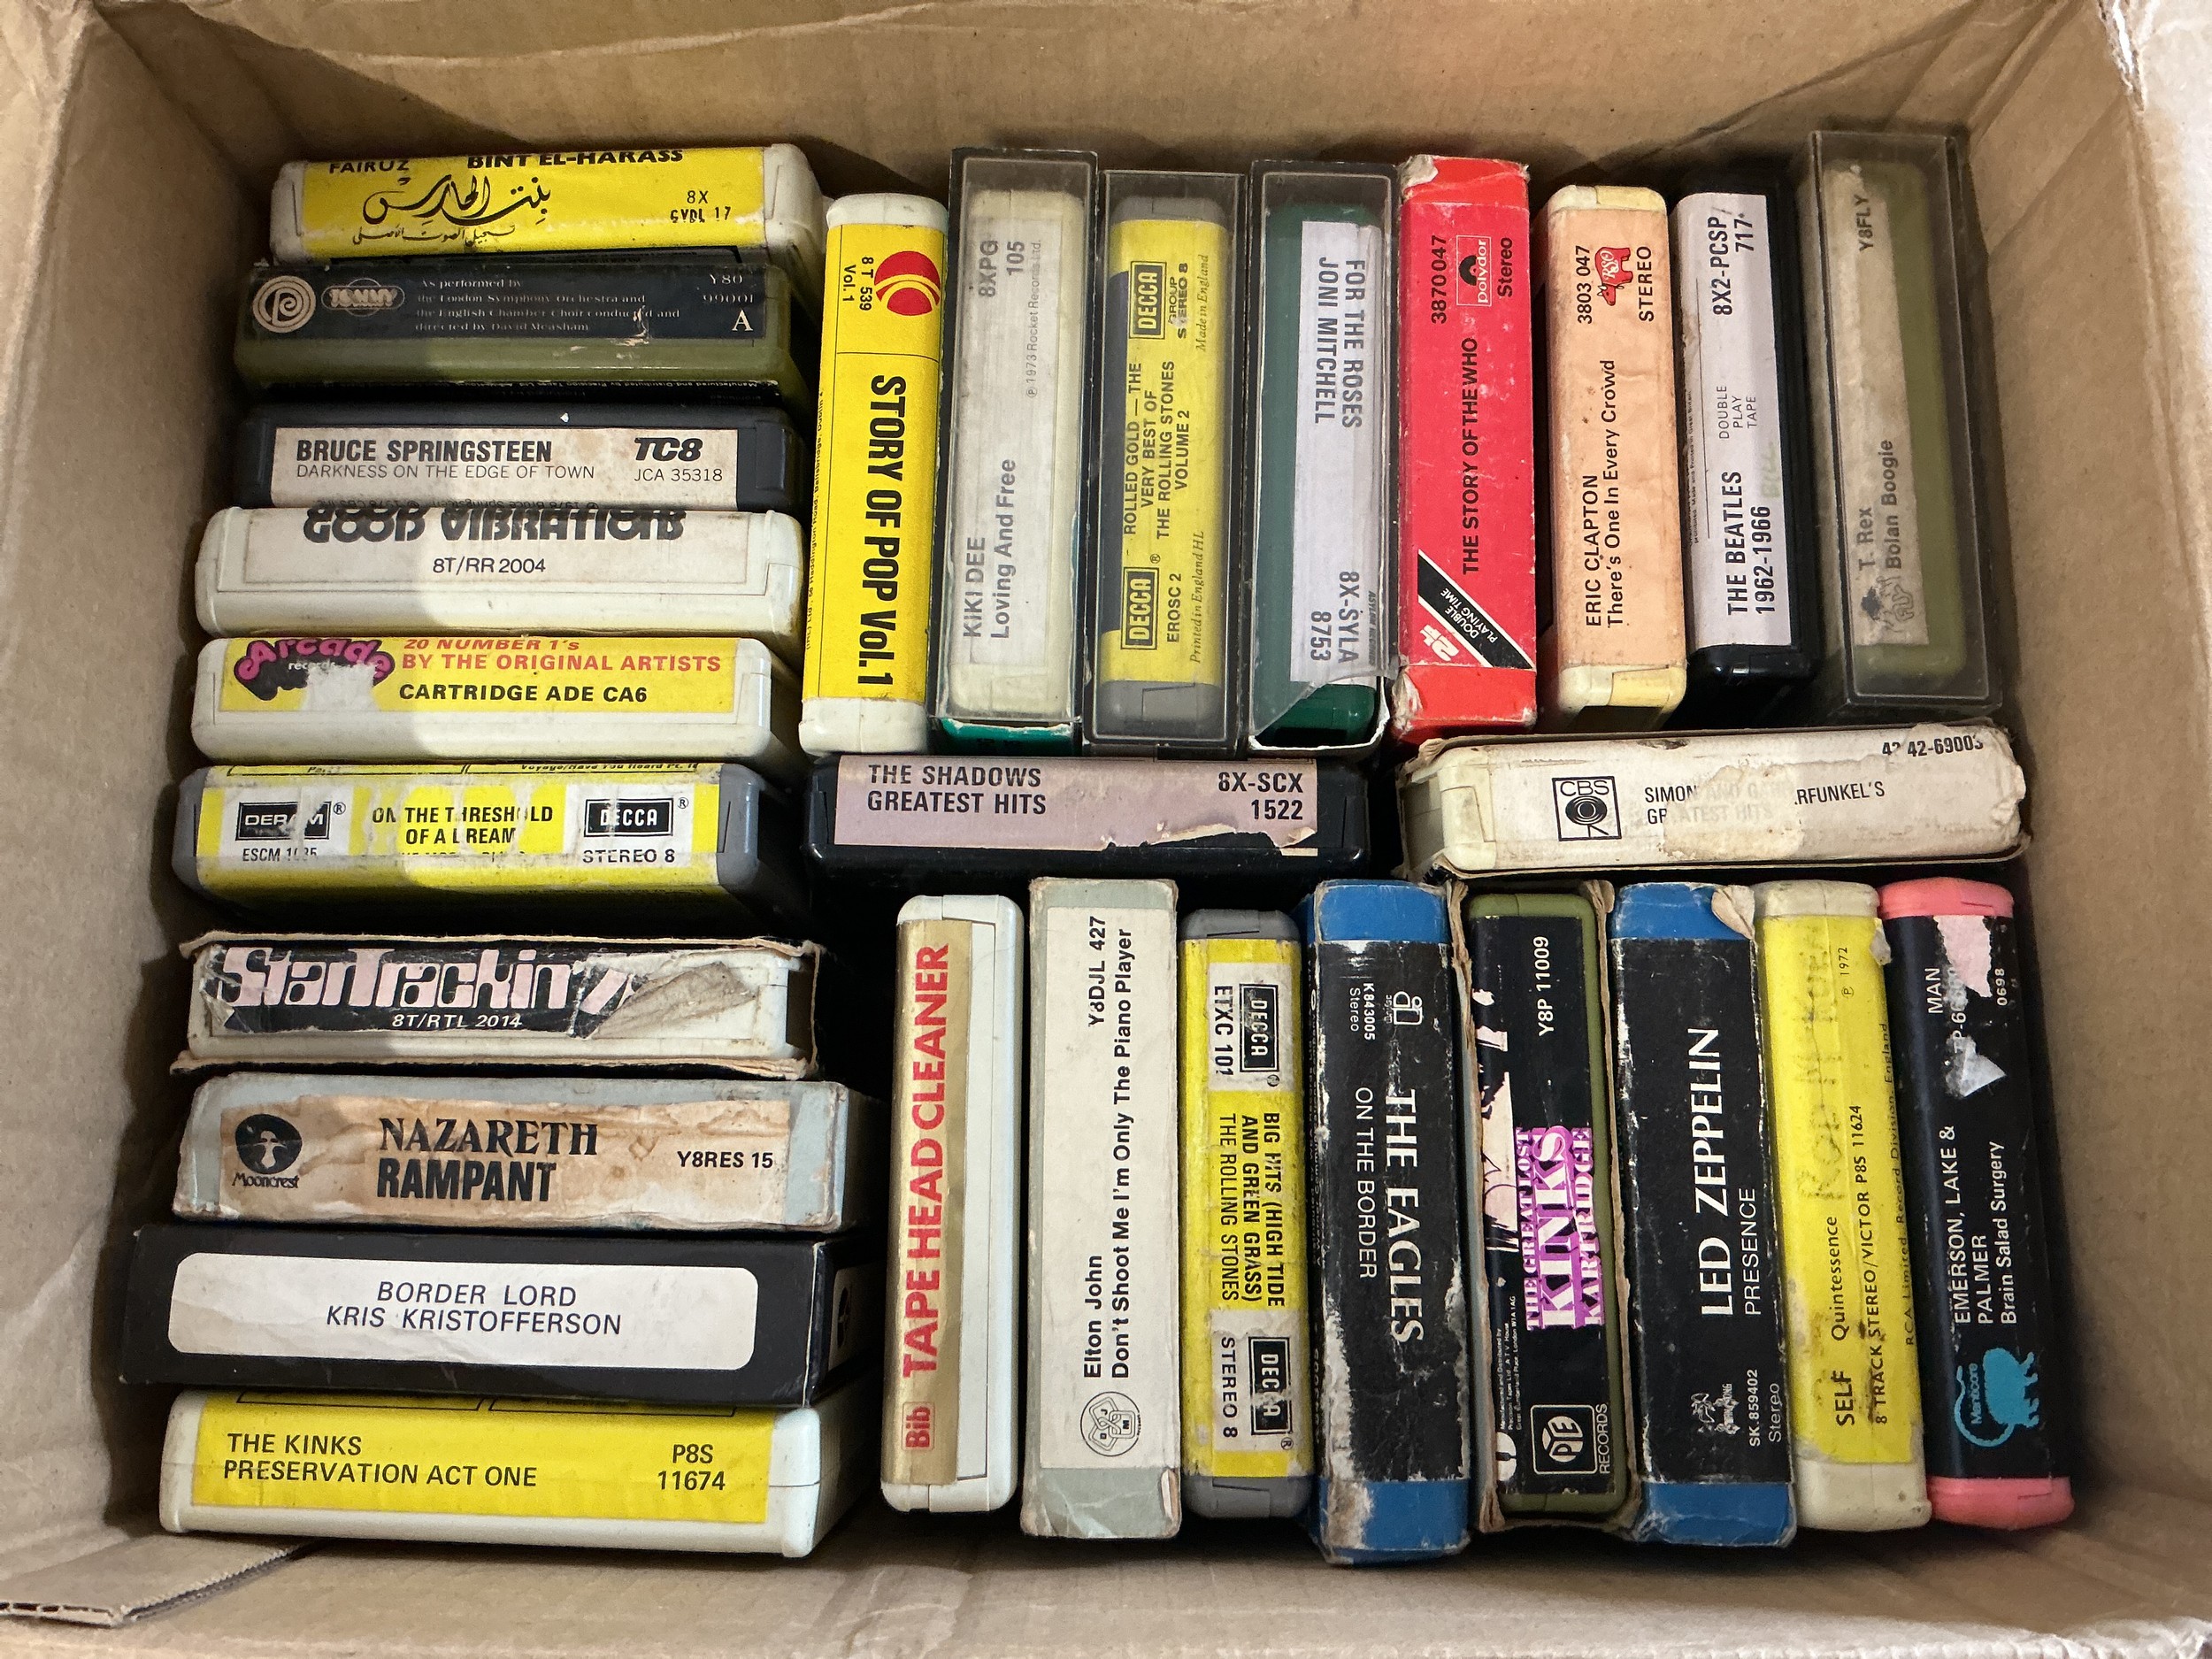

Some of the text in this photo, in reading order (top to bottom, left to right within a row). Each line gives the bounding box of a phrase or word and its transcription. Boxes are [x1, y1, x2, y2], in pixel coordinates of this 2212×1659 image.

[330, 160, 410, 173] FAIRUZ
[467, 155, 531, 168] BINT
[1477, 239, 1488, 303] polydor
[1707, 216, 1732, 316] 8X2-PCSP
[1026, 311, 1039, 350] Rocket
[1195, 254, 1209, 351] Made in England
[1025, 354, 1037, 384] 1973
[1315, 257, 1339, 424] JONI MITCHELL
[1341, 259, 1366, 428] FOR THE ROSES
[867, 374, 907, 481] STORY
[1716, 385, 1730, 439] DOUBLE
[1732, 395, 1743, 428] PLAY
[1746, 396, 1757, 428] TAPE
[296, 437, 704, 463] BRUCE SPRINGSTEEN TC8
[296, 464, 595, 480] DARKNESS ON THE EDGE OF TOWN
[1157, 361, 1174, 539] THE ROLLING STONES
[1462, 338, 1479, 575] THE STORY OF THE WHO
[303, 507, 687, 543] GOOD VIBRATIONS
[865, 489, 902, 528] OF
[1600, 360, 1624, 627] There's One In Every Crowd
[1878, 440, 1901, 570] Bolan Boogie
[862, 535, 901, 602] POP
[991, 458, 1016, 639] Loving And Free
[1582, 475, 1601, 626] ERIC CLAPTON
[1721, 471, 1748, 616] THE BEATLES
[1750, 506, 1776, 614] 1962-1966
[1856, 507, 1875, 571] T. Rex
[963, 536, 986, 638] KIKI DEE
[402, 654, 720, 672] BY THE ORIGINAL ARTISTS
[858, 610, 897, 667] Vol.
[398, 684, 647, 703] CARTRIDGE ADE CA6
[867, 791, 1047, 815] GREATEST HITS
[868, 764, 1303, 795] THE SHADOWS 8X-SCX
[1559, 780, 1610, 797] CBS
[1532, 936, 1555, 1036] Y8P 11009
[1838, 947, 1850, 976] 1972
[392, 1013, 522, 1028] 8T/RTL 2014
[1878, 1023, 1893, 1083] England
[379, 1117, 599, 1158] NAZARETH
[902, 943, 949, 1378] TAPE HEAD CLEANER
[1111, 928, 1135, 1379] Don't Shoot Me I'm Only The Piano Player
[232, 1171, 300, 1190] Mooncrest
[376, 1149, 773, 1202] RAMPANT Y8RES 15
[1355, 1087, 1378, 1279] ON THE BORDER
[1687, 1028, 1734, 1316] LED ZEPPELIN
[1892, 1168, 1907, 1224] Record
[1263, 1112, 1285, 1307] BIG HITS (HIGH TIDE
[1386, 1088, 1425, 1343] THE EAGLES
[1532, 1126, 1576, 1326] KINKS
[1571, 1127, 1603, 1325] KARTRIDGE
[1939, 1125, 1972, 1324] EMERSON, LAKE &
[1988, 1141, 2018, 1325] Brain Salad Surgery
[1738, 1187, 1763, 1315] PRESENCE
[1971, 1234, 1994, 1325] PALMER
[326, 1306, 622, 1336] KRIS KRISTOFFERSON
[376, 1280, 578, 1308] BORDER LORD
[1084, 1256, 1102, 1379] Elton John
[1825, 1216, 1855, 1426] SELF Quintessence
[1903, 1310, 1916, 1345] RCA
[906, 1405, 931, 1448] Bib
[1747, 1369, 1761, 1447] SK.859402
[1968, 1363, 1983, 1425] Manticore
[1541, 1416, 1584, 1463] PYE
[1596, 1403, 1611, 1474] RECORDS
[223, 1460, 537, 1487] PRESERVATION ACT ONE
